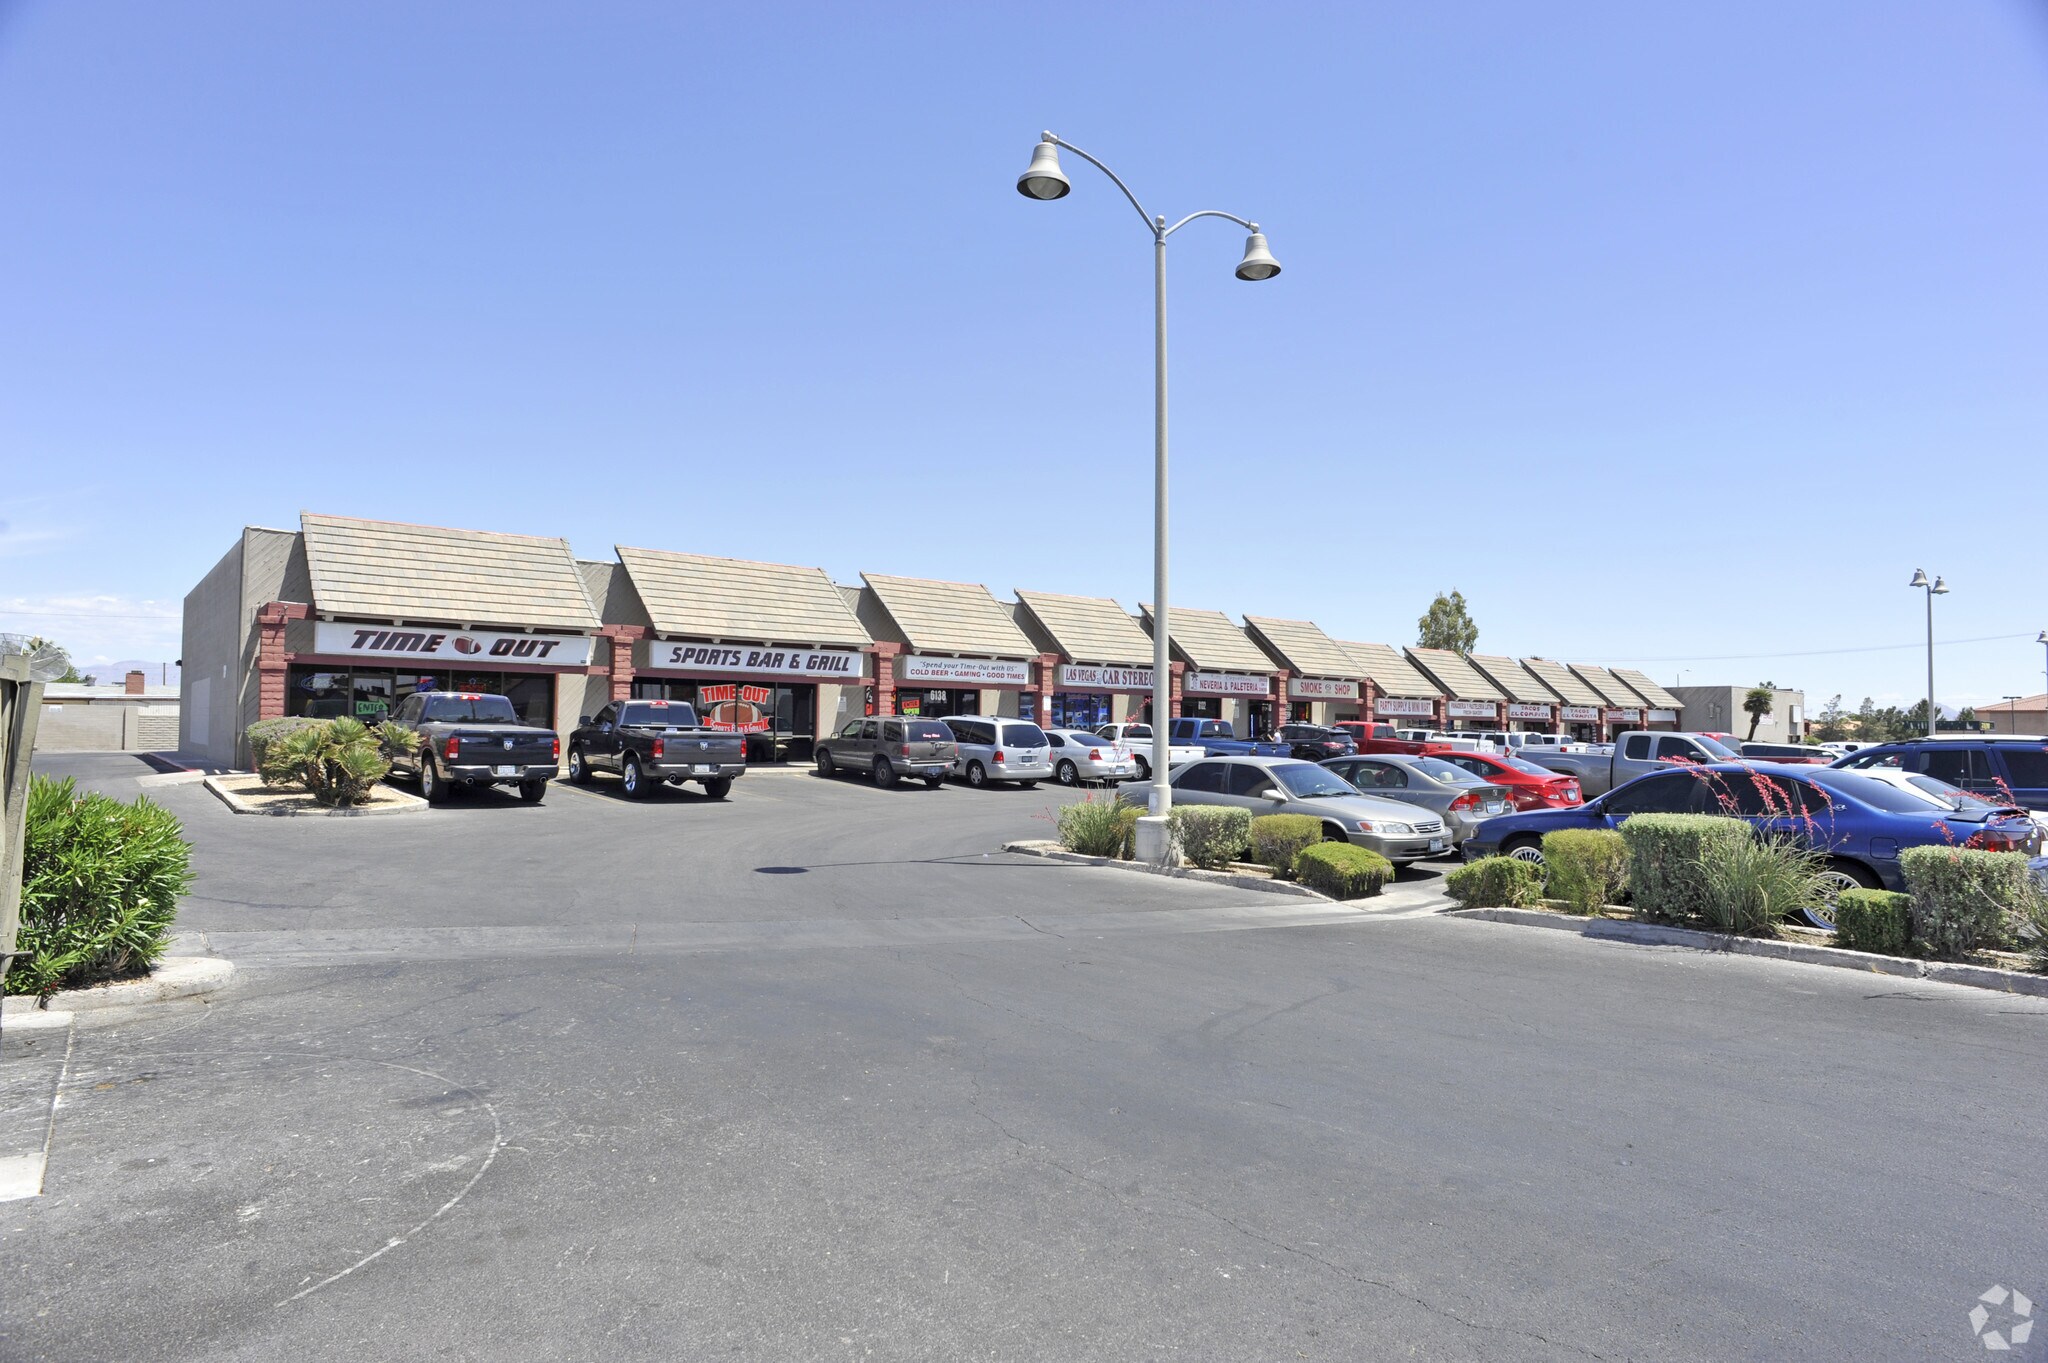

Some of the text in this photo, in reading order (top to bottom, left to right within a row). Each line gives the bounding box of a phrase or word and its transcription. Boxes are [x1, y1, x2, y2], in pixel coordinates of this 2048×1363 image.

[351, 630, 561, 658] TIME OUT
[669, 646, 850, 671] SPORTS BAR & GRILL
[943, 662, 959, 671] your
[991, 664, 1005, 672] with
[910, 668, 929, 676] COLD
[954, 670, 981, 678] GAMING
[986, 671, 1005, 679] GOOD
[1065, 668, 1154, 687] LAS VEGAS CAR STEREO
[1200, 680, 1223, 691] NEVERIA
[1230, 681, 1258, 692] PALETERIA
[1300, 682, 1351, 695] SMOKE SHOP
[930, 690, 947, 701] 6138
[1379, 700, 1392, 712] PARTY
